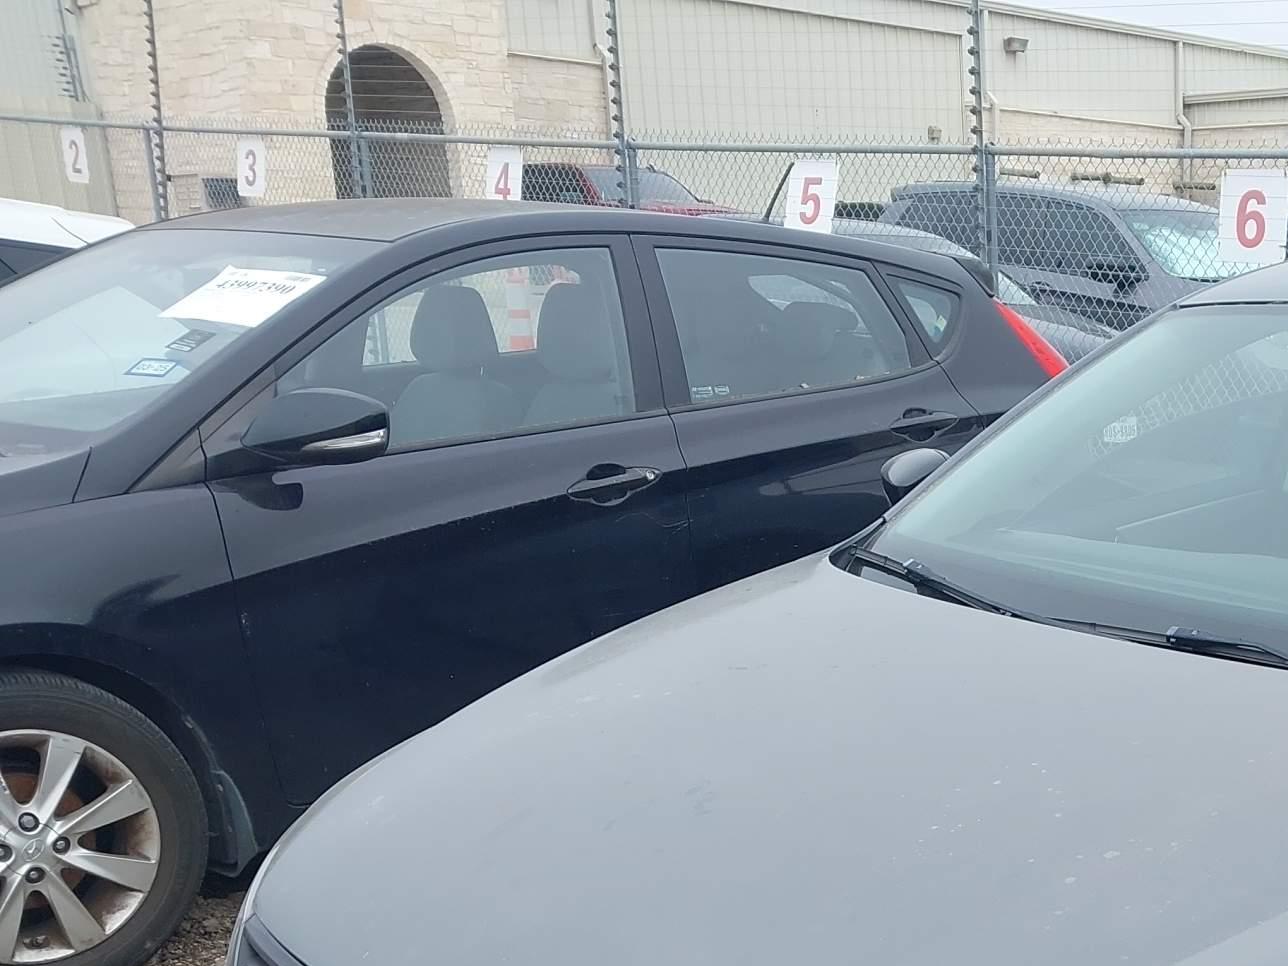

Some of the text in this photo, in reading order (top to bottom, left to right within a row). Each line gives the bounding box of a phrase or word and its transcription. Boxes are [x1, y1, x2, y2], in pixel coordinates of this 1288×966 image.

[69, 140, 83, 174] 2
[244, 149, 257, 187] 3
[494, 162, 511, 200] 4
[800, 177, 822, 224] 5
[1236, 189, 1266, 248] 6
